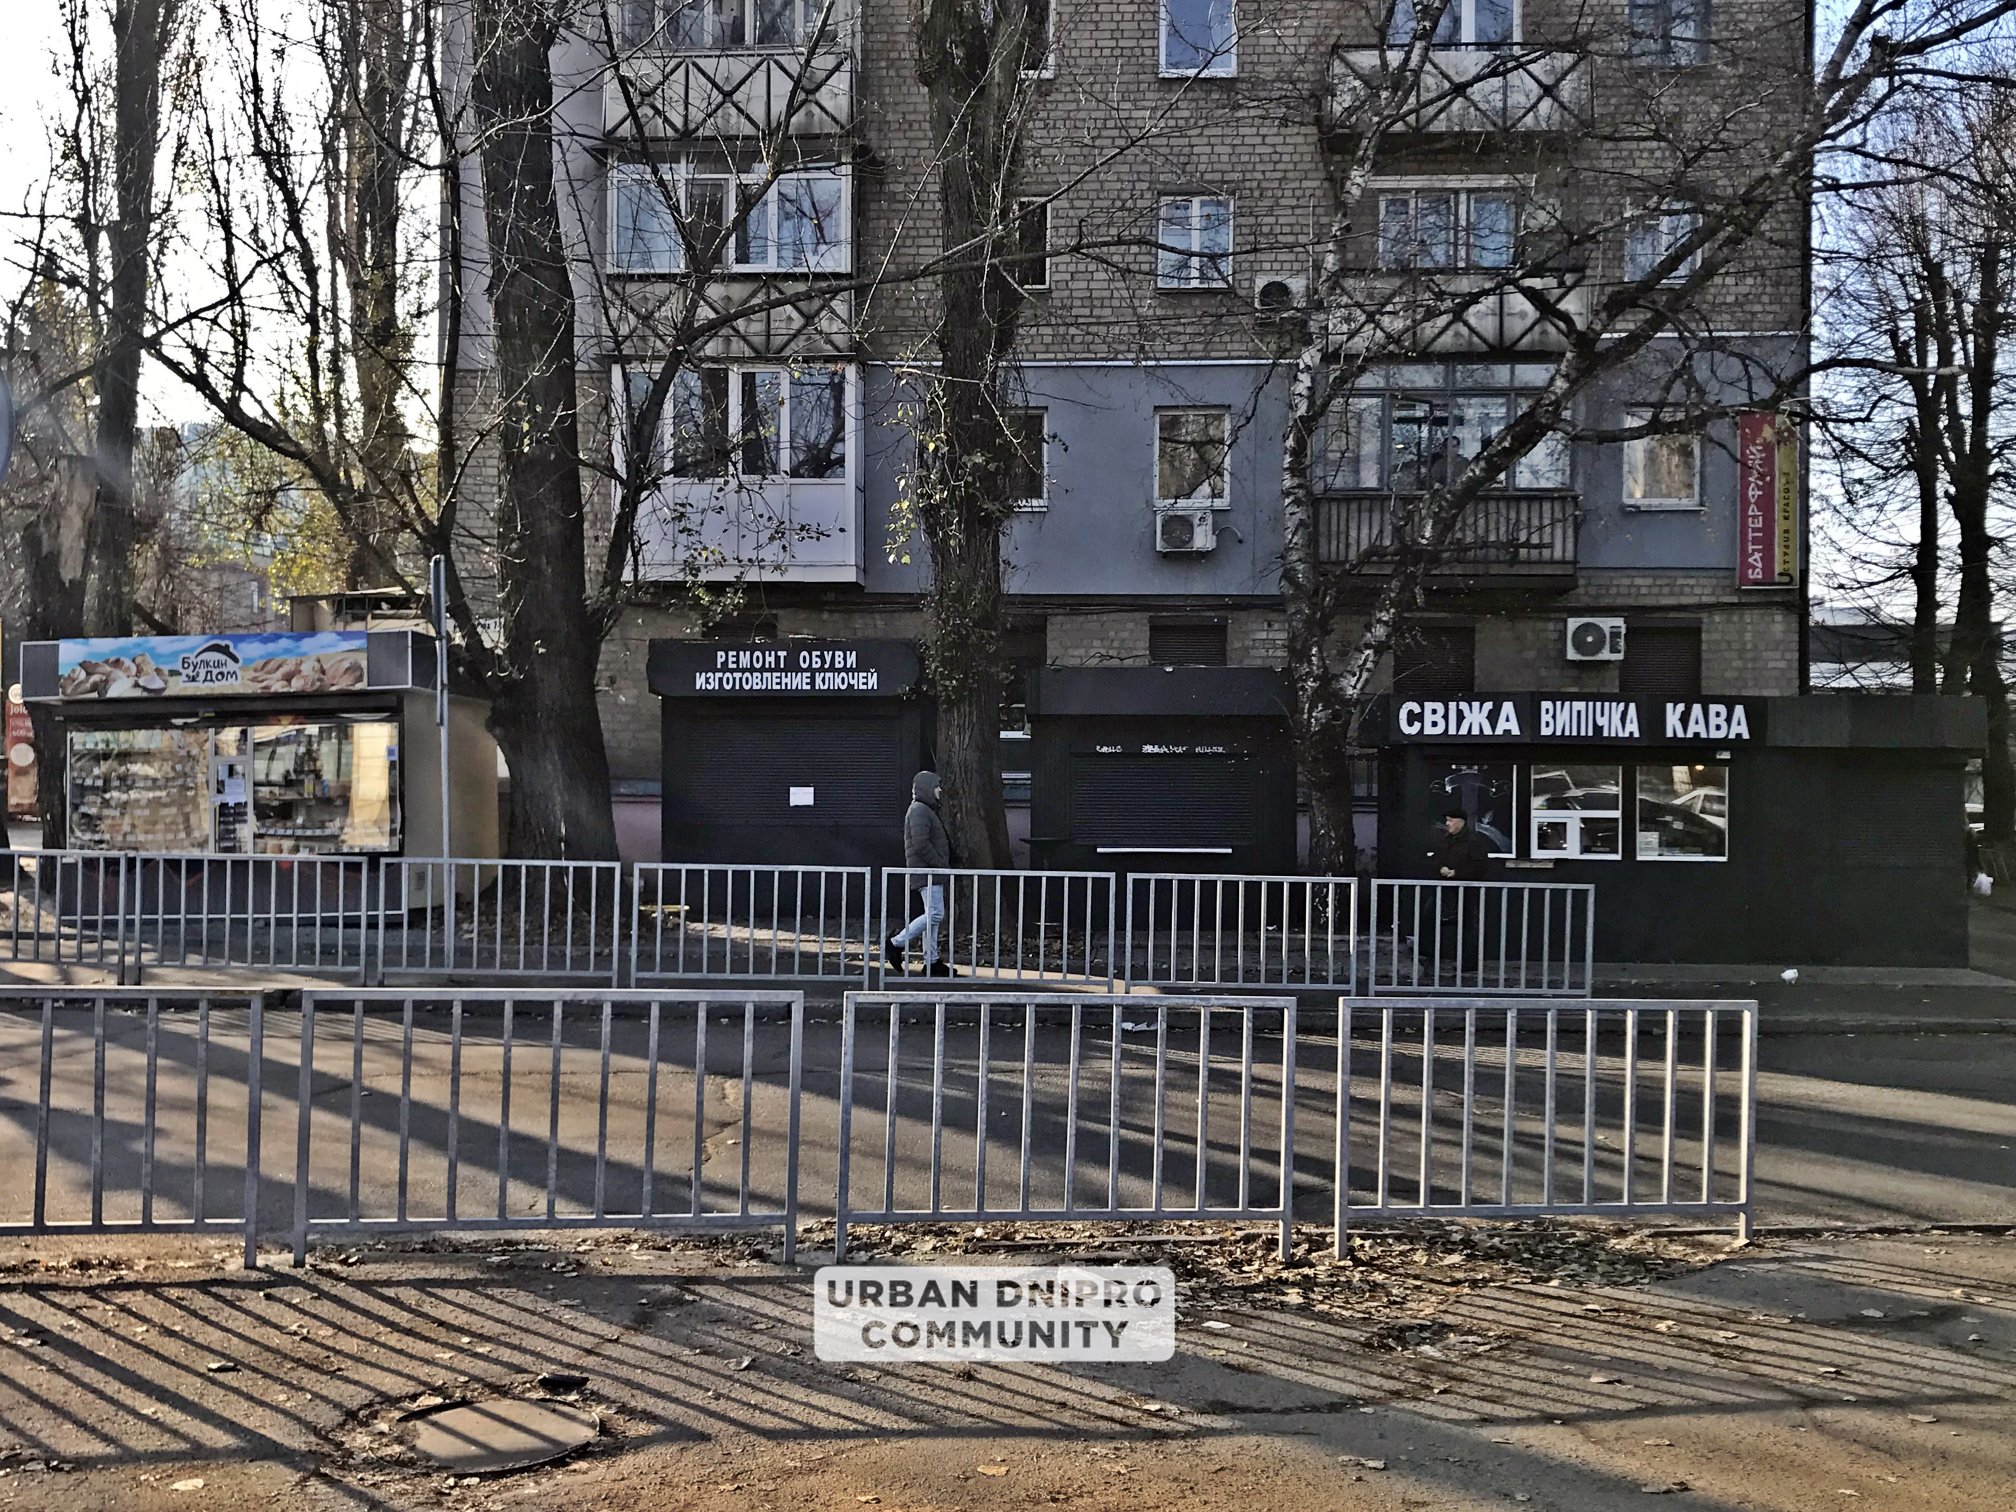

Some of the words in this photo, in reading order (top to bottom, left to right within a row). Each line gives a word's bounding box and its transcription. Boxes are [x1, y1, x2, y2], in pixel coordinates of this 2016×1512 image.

[181, 656, 228, 673] Булкин
[716, 650, 787, 669] РЕМОНТ
[799, 650, 857, 669] ОБУВИ
[695, 672, 811, 690] ИЗГОТОВЛЕНИЕ
[815, 668, 878, 690] КЛЮЧЕЙ
[1399, 700, 1521, 736] СВІЖА
[1540, 700, 1640, 738] ВИПІЧКА
[1665, 702, 1750, 739] КАВА
